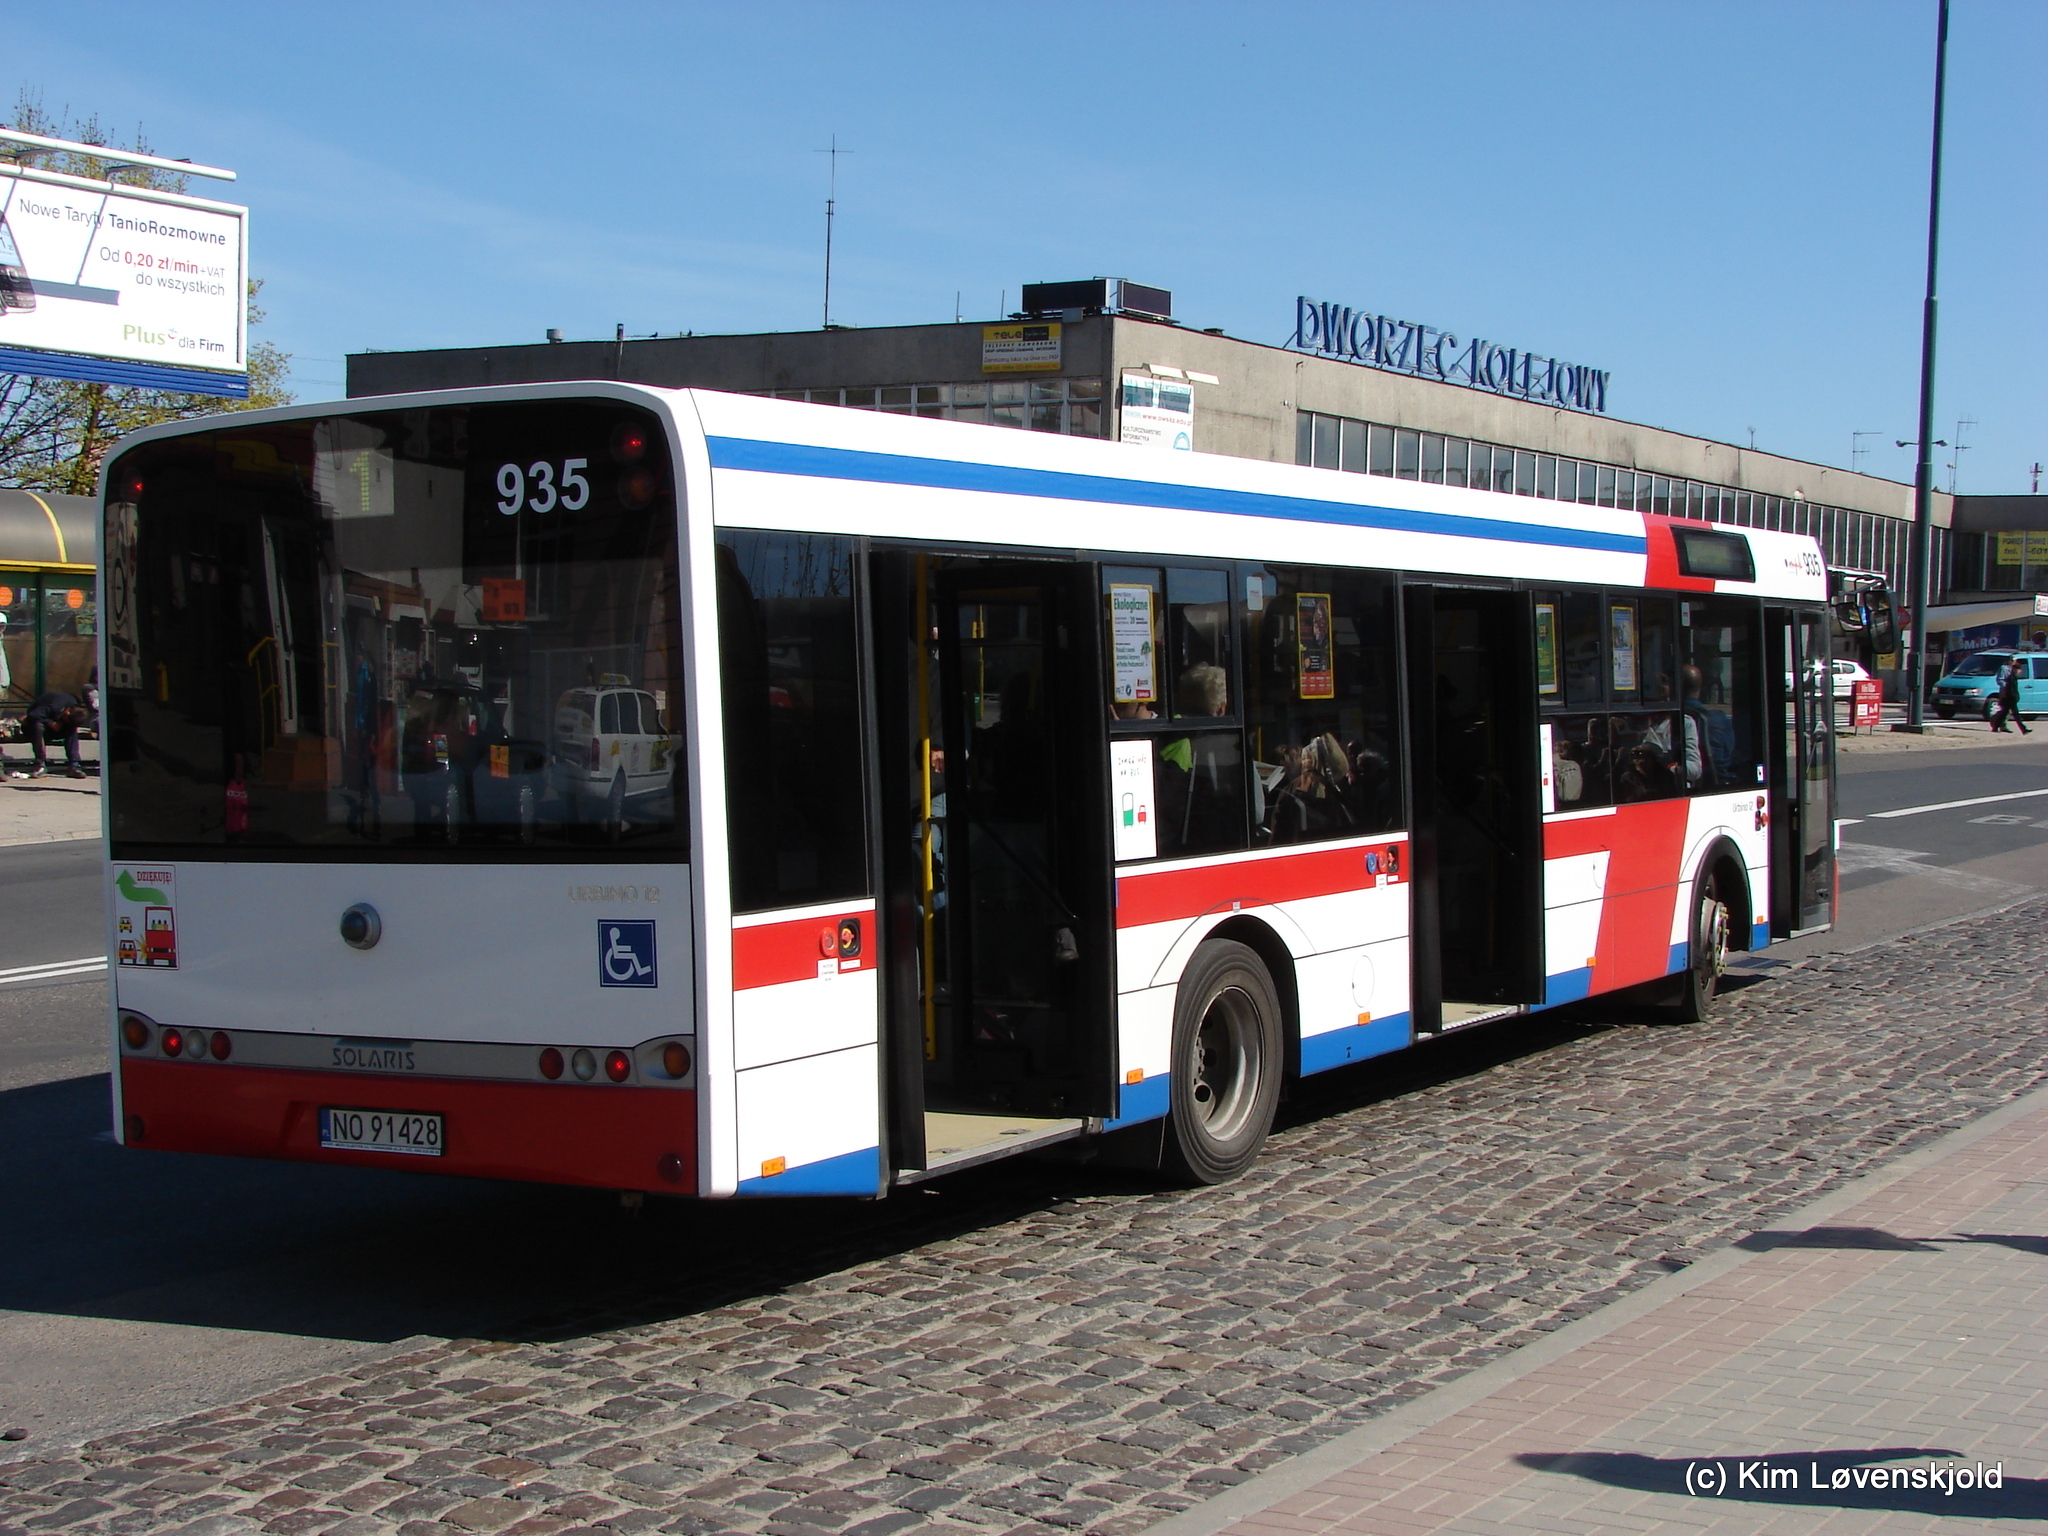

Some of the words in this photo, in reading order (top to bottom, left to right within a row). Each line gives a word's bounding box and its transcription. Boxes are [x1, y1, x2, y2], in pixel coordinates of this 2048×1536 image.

[20, 198, 60, 219] Nowe
[65, 206, 104, 229] Taryfy
[109, 213, 226, 246] TanioRozmowne
[100, 247, 120, 263] Od
[124, 251, 153, 269] 0,20
[136, 272, 153, 286] do
[157, 275, 225, 296] wszystkich
[123, 323, 166, 346] Plus
[178, 336, 196, 350] dla
[199, 338, 225, 353] Firm
[1297, 296, 1458, 378] DWORZEC
[1471, 338, 1611, 412] KOLEJOWY
[496, 457, 590, 516] 935
[1803, 552, 1821, 577] 935
[568, 885, 638, 904] URBINO
[642, 885, 660, 904] 12
[332, 1047, 415, 1070] SOLARIS
[333, 1112, 363, 1141] NO
[371, 1115, 438, 1146] 91428
